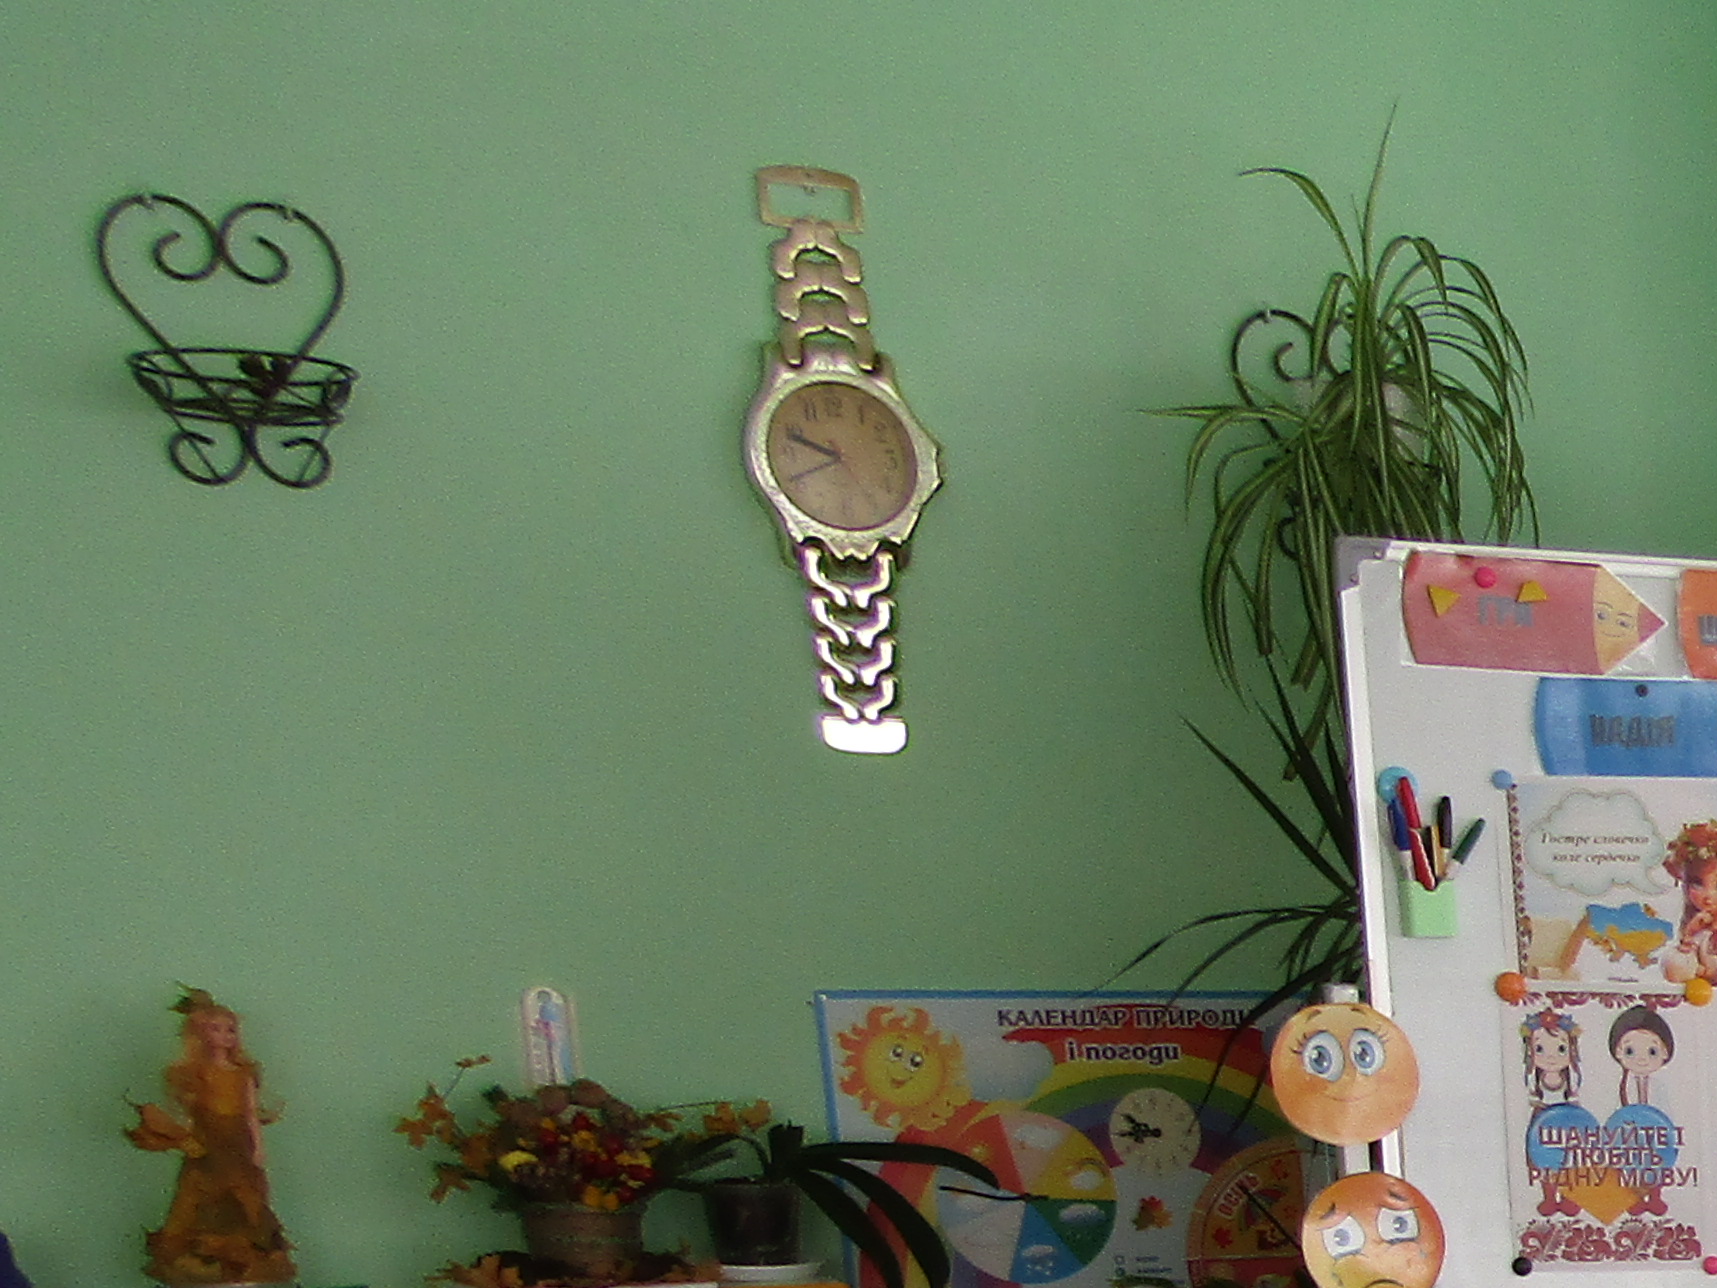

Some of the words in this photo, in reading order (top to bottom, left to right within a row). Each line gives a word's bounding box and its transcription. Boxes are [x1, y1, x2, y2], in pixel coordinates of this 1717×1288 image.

[997, 1009, 1127, 1027] КАЛЕНДАР
[1068, 1042, 1077, 1061] і
[1085, 1044, 1181, 1064] погоди
[1538, 1121, 1668, 1147] ШАНУЙТЕ
[1561, 1147, 1664, 1167] ЛЮБІТЬ
[1617, 1167, 1698, 1189] МОВУ!
